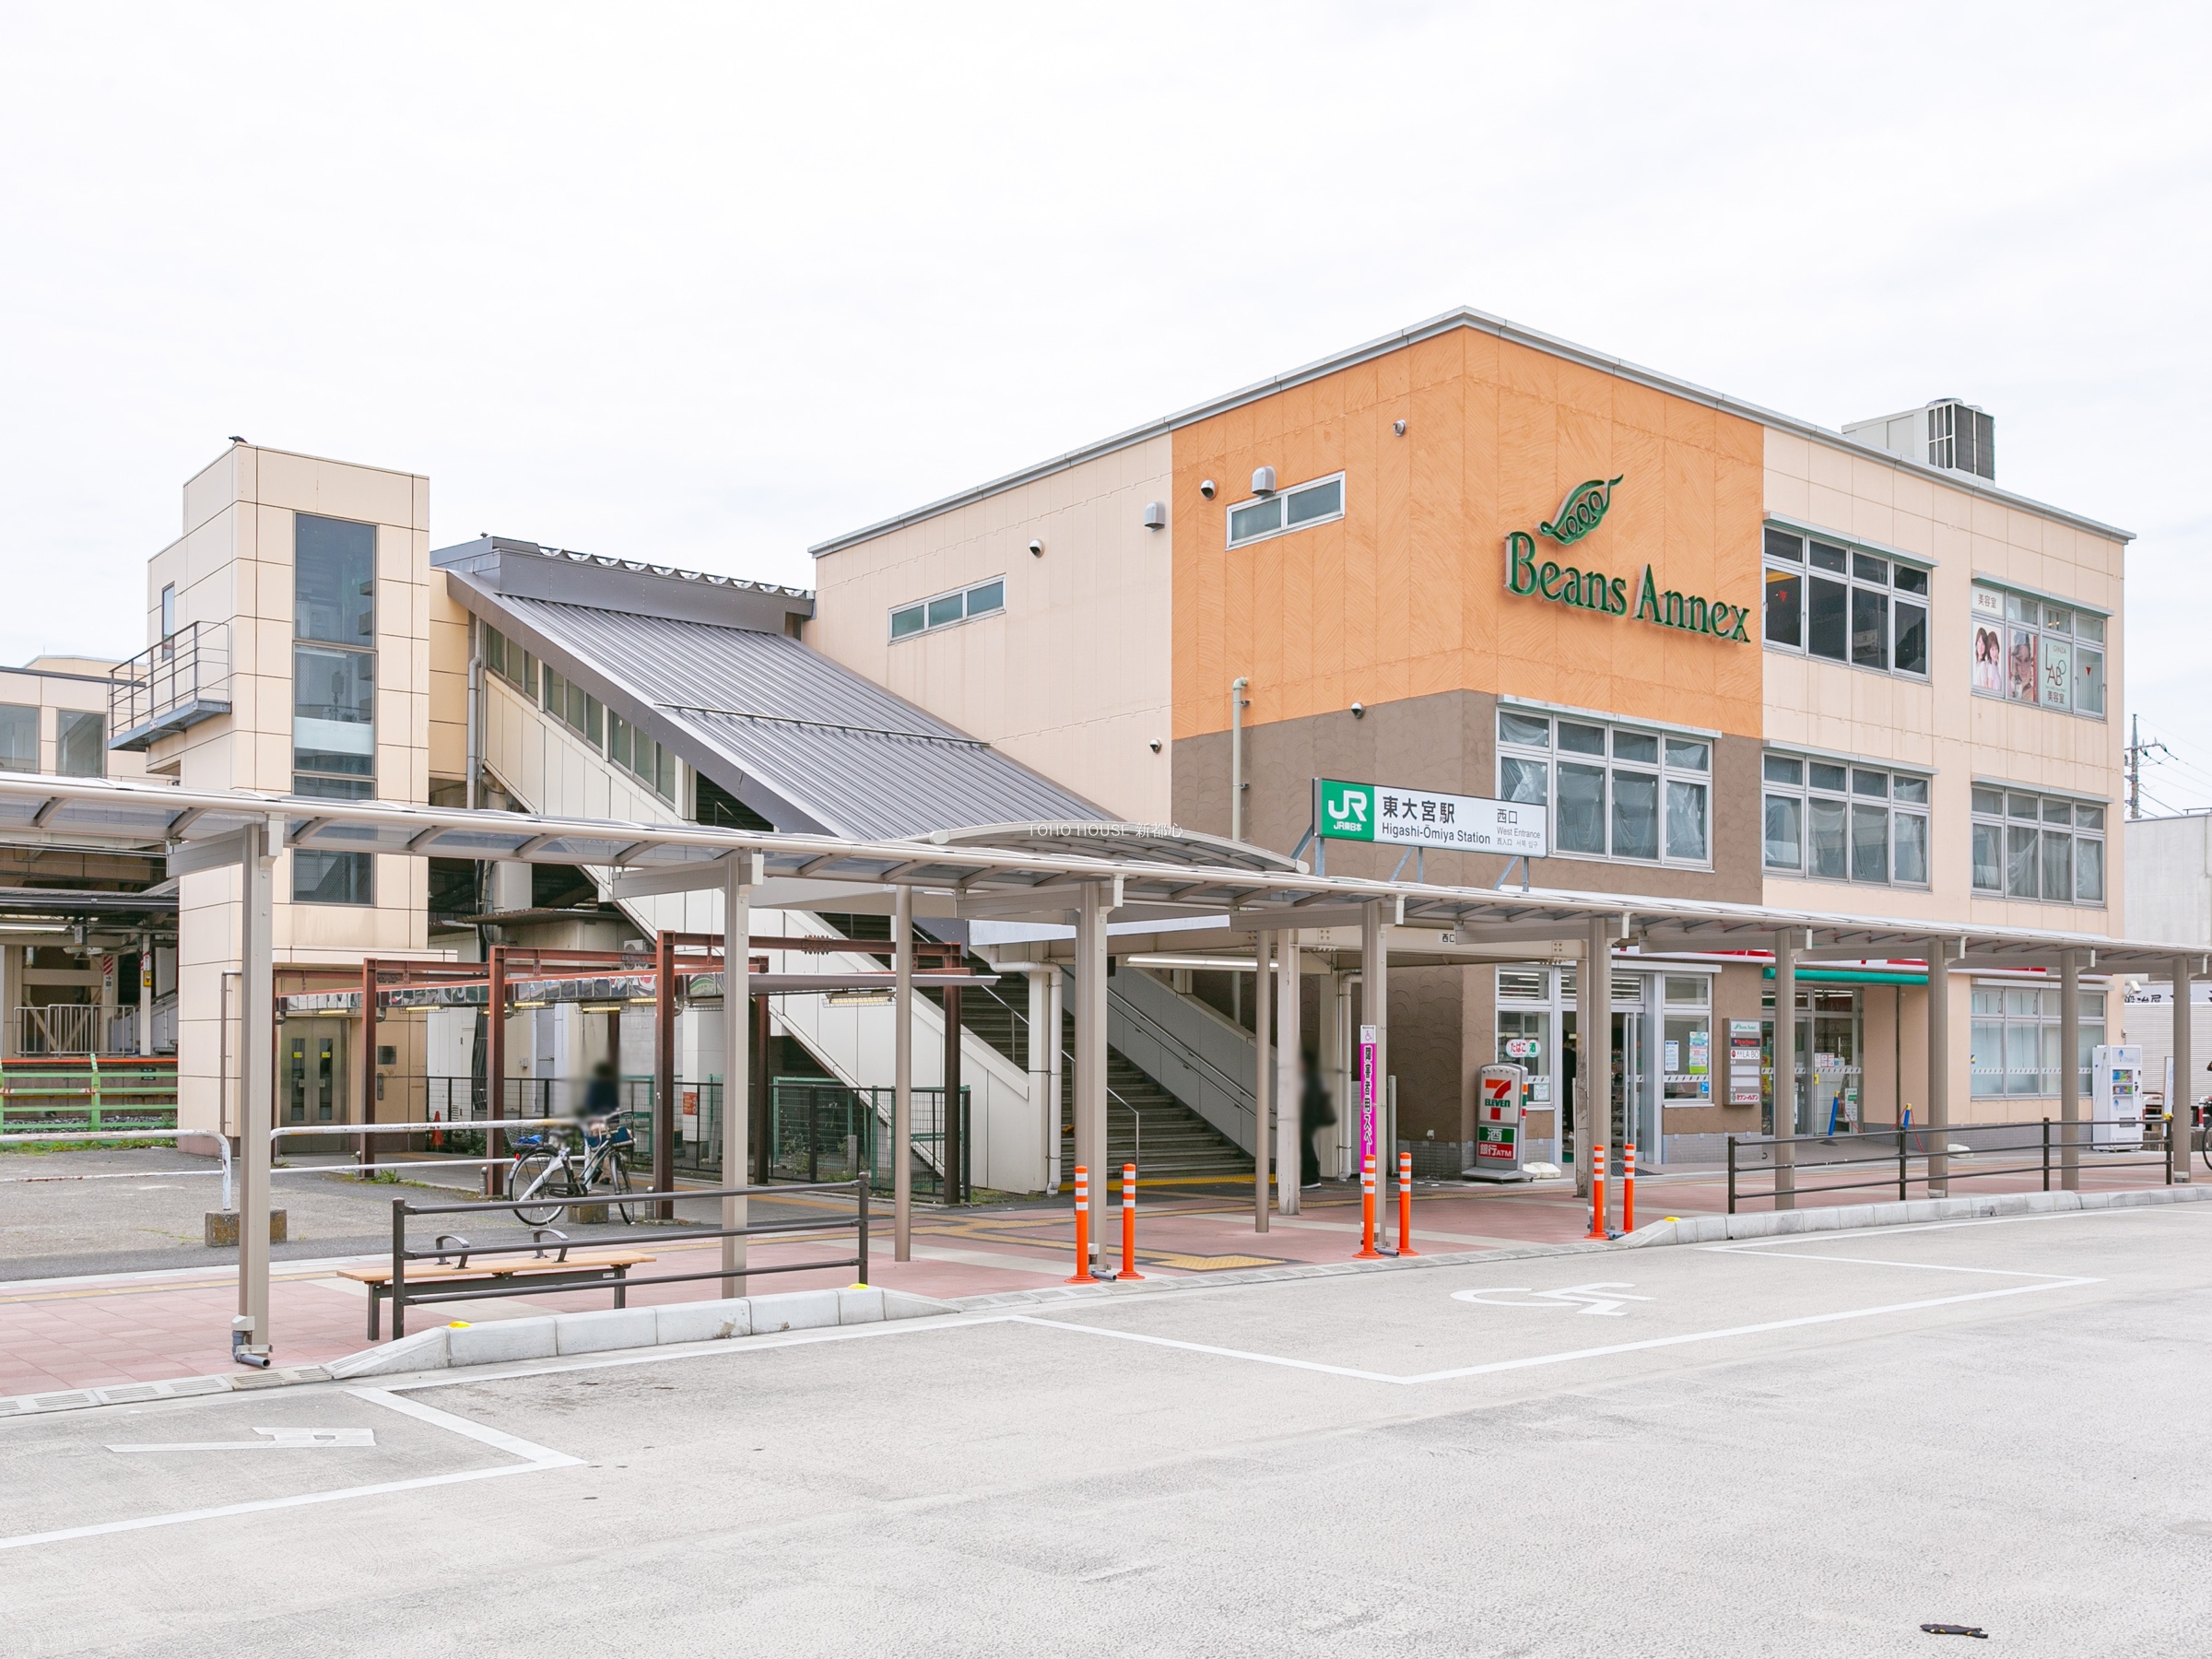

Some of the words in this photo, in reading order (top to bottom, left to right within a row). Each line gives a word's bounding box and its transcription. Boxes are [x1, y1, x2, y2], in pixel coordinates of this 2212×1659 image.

[1505, 531, 1628, 617] Beans
[1634, 563, 1750, 643] Annex
[1978, 594, 1997, 609] 美容室
[2047, 690, 2065, 705] 美容室
[1328, 790, 1367, 822] JR
[1382, 795, 1455, 824] 東大宮駅
[1497, 808, 1518, 825] 西口
[1333, 821, 1362, 832] JR東日本
[1382, 822, 1454, 841] Higashi-Ōmiya
[1457, 830, 1491, 845] Station
[1497, 826, 1512, 836] West
[1513, 828, 1541, 839] Entrance
[1497, 838, 1512, 846] 西入口
[1528, 841, 1538, 849] 입구
[1510, 1042, 1526, 1053] たばこ
[1529, 1042, 1536, 1053] 酒
[1364, 1046, 1373, 1155] 障害者用スペー
[1485, 1079, 1512, 1120] 7
[1487, 1127, 1503, 1142] 酒
[1479, 1144, 1512, 1157] 銀行ATM
